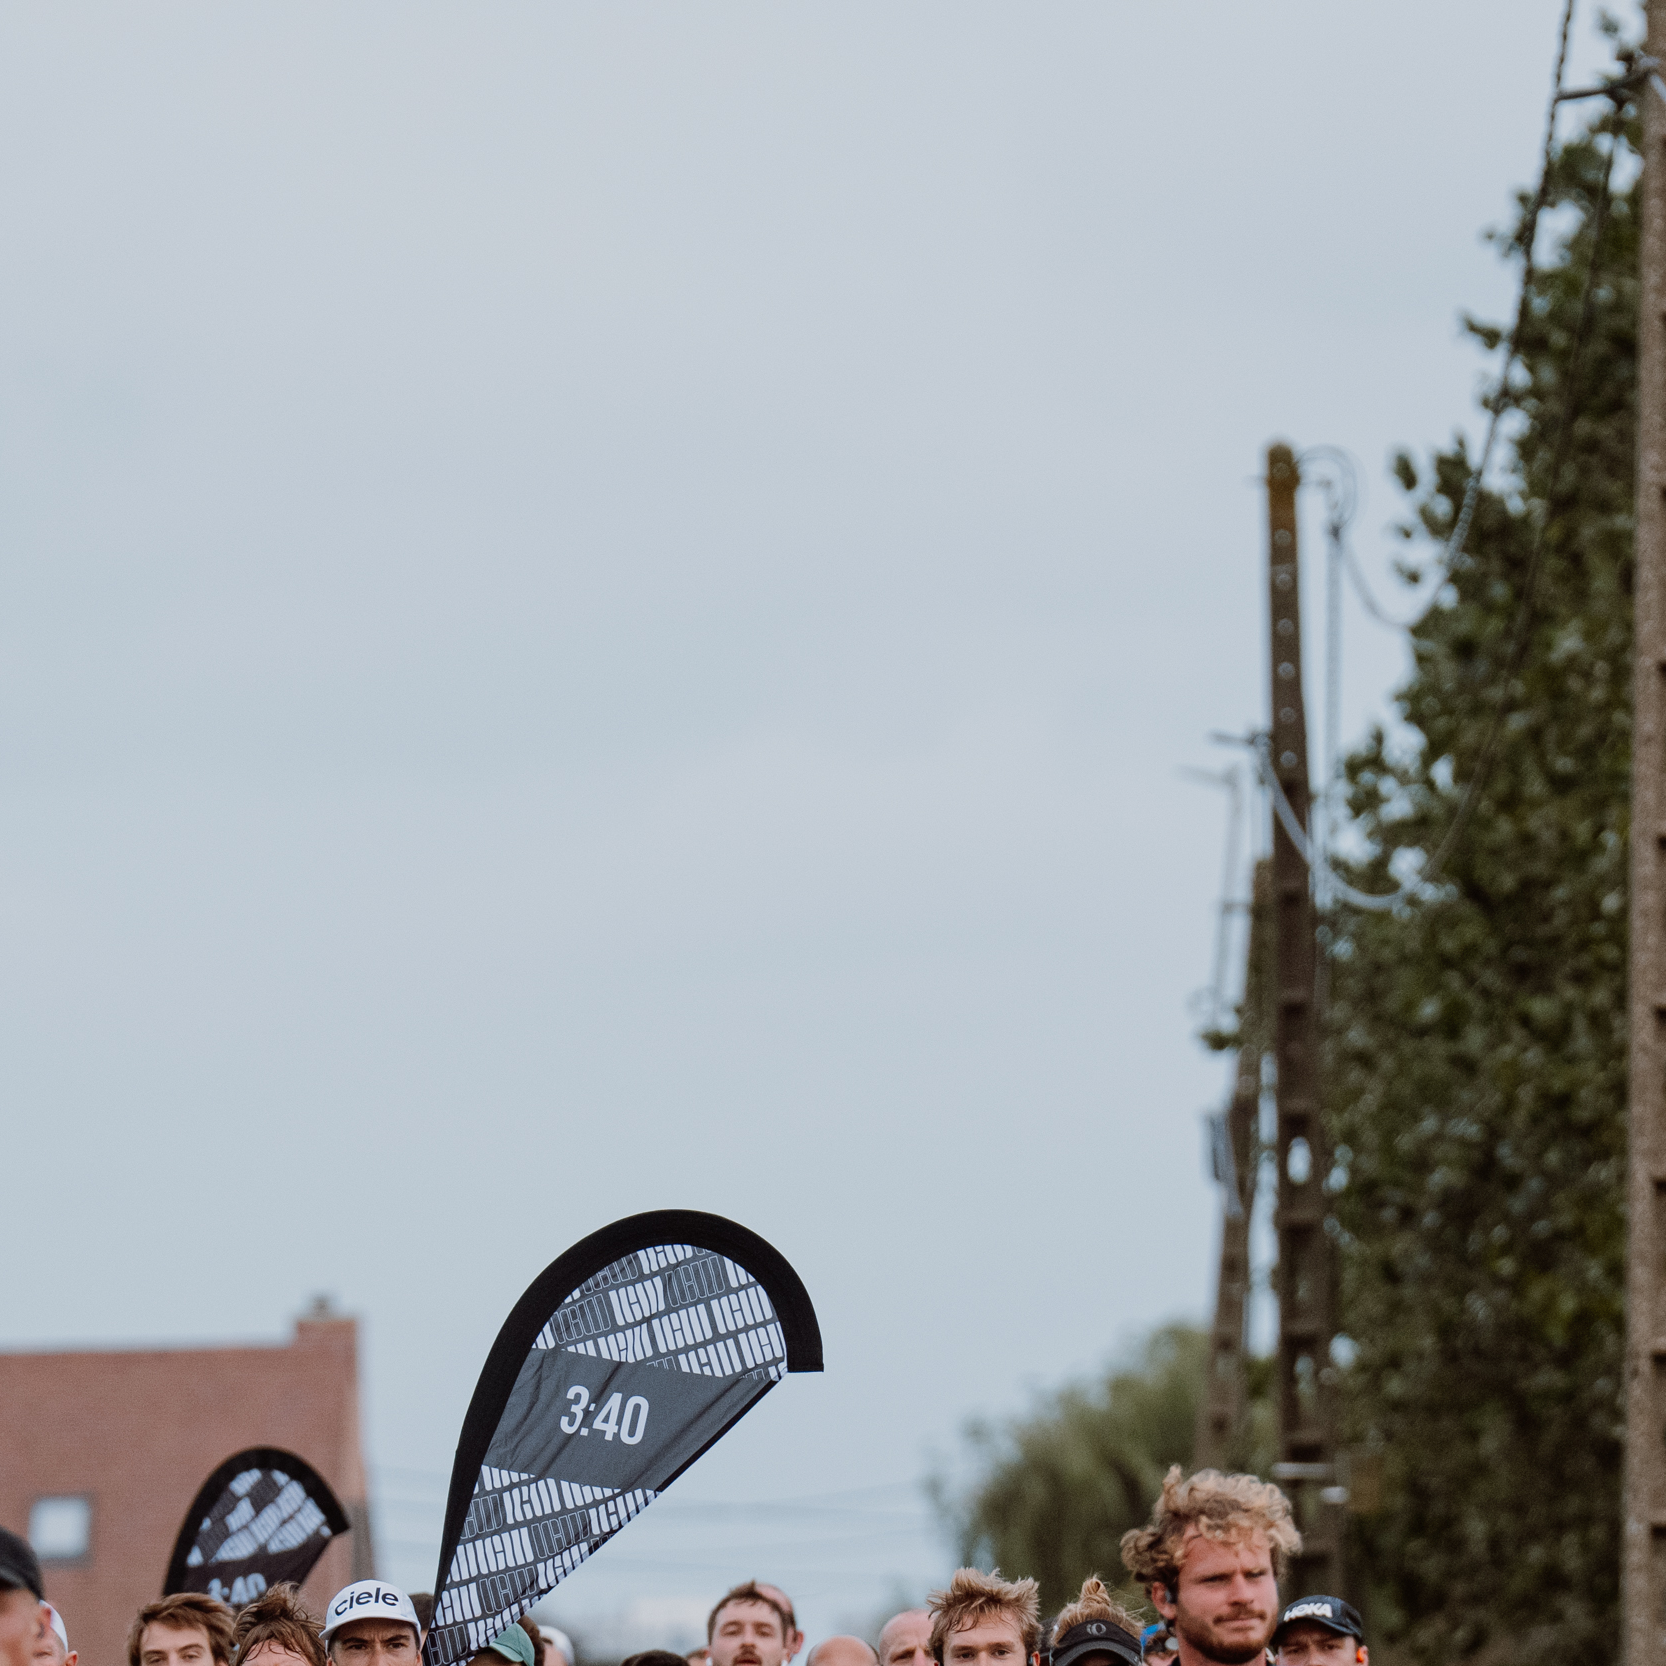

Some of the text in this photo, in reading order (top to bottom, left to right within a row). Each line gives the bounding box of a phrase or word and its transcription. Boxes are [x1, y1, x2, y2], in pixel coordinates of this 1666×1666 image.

[559, 1385, 650, 1445] 3:40
[335, 1587, 399, 1616] ciele
[1283, 1602, 1333, 1622] HOKA
